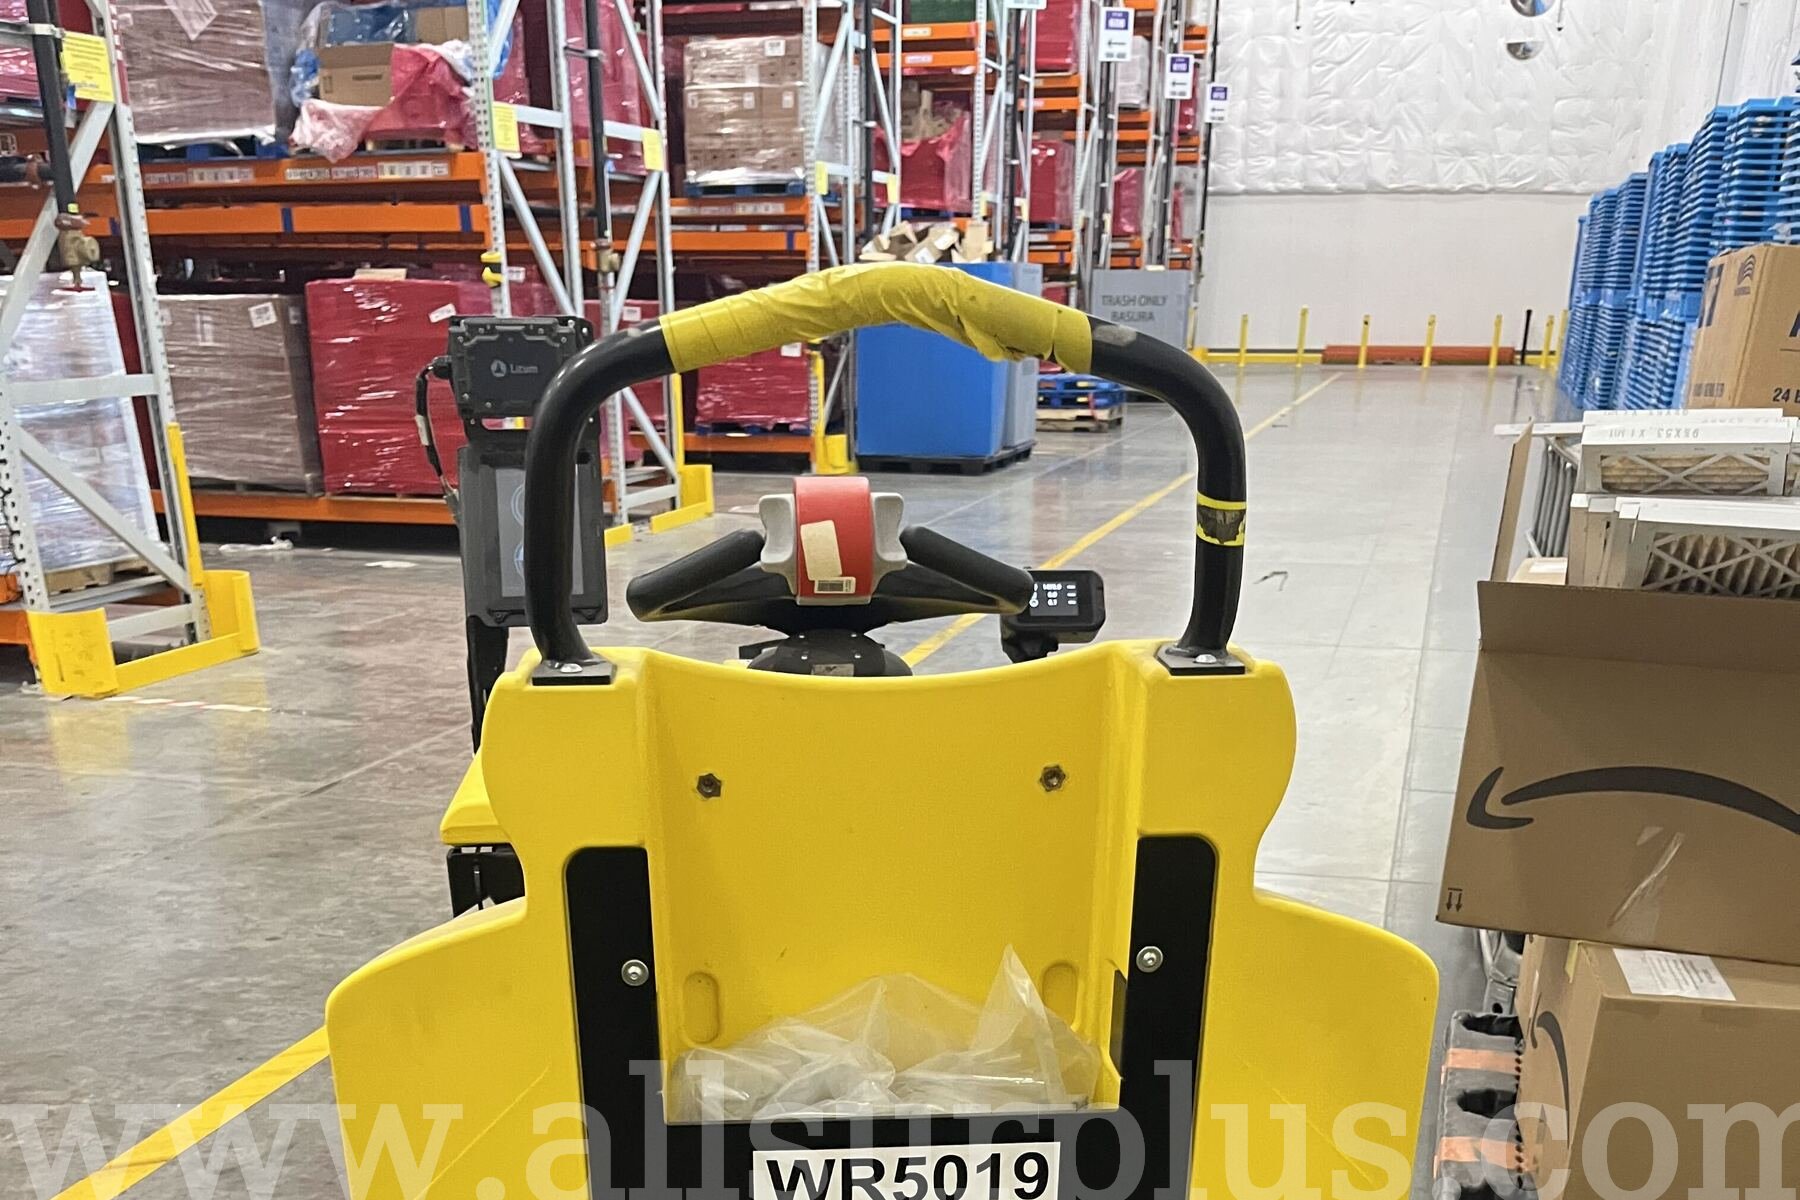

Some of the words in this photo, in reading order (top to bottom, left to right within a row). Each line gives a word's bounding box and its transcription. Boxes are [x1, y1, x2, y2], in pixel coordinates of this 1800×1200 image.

[1102, 295, 1136, 306] TRASH
[1138, 295, 1168, 306] ONLY
[1111, 312, 1155, 321] BASURA
[1772, 387, 1791, 402] 24
